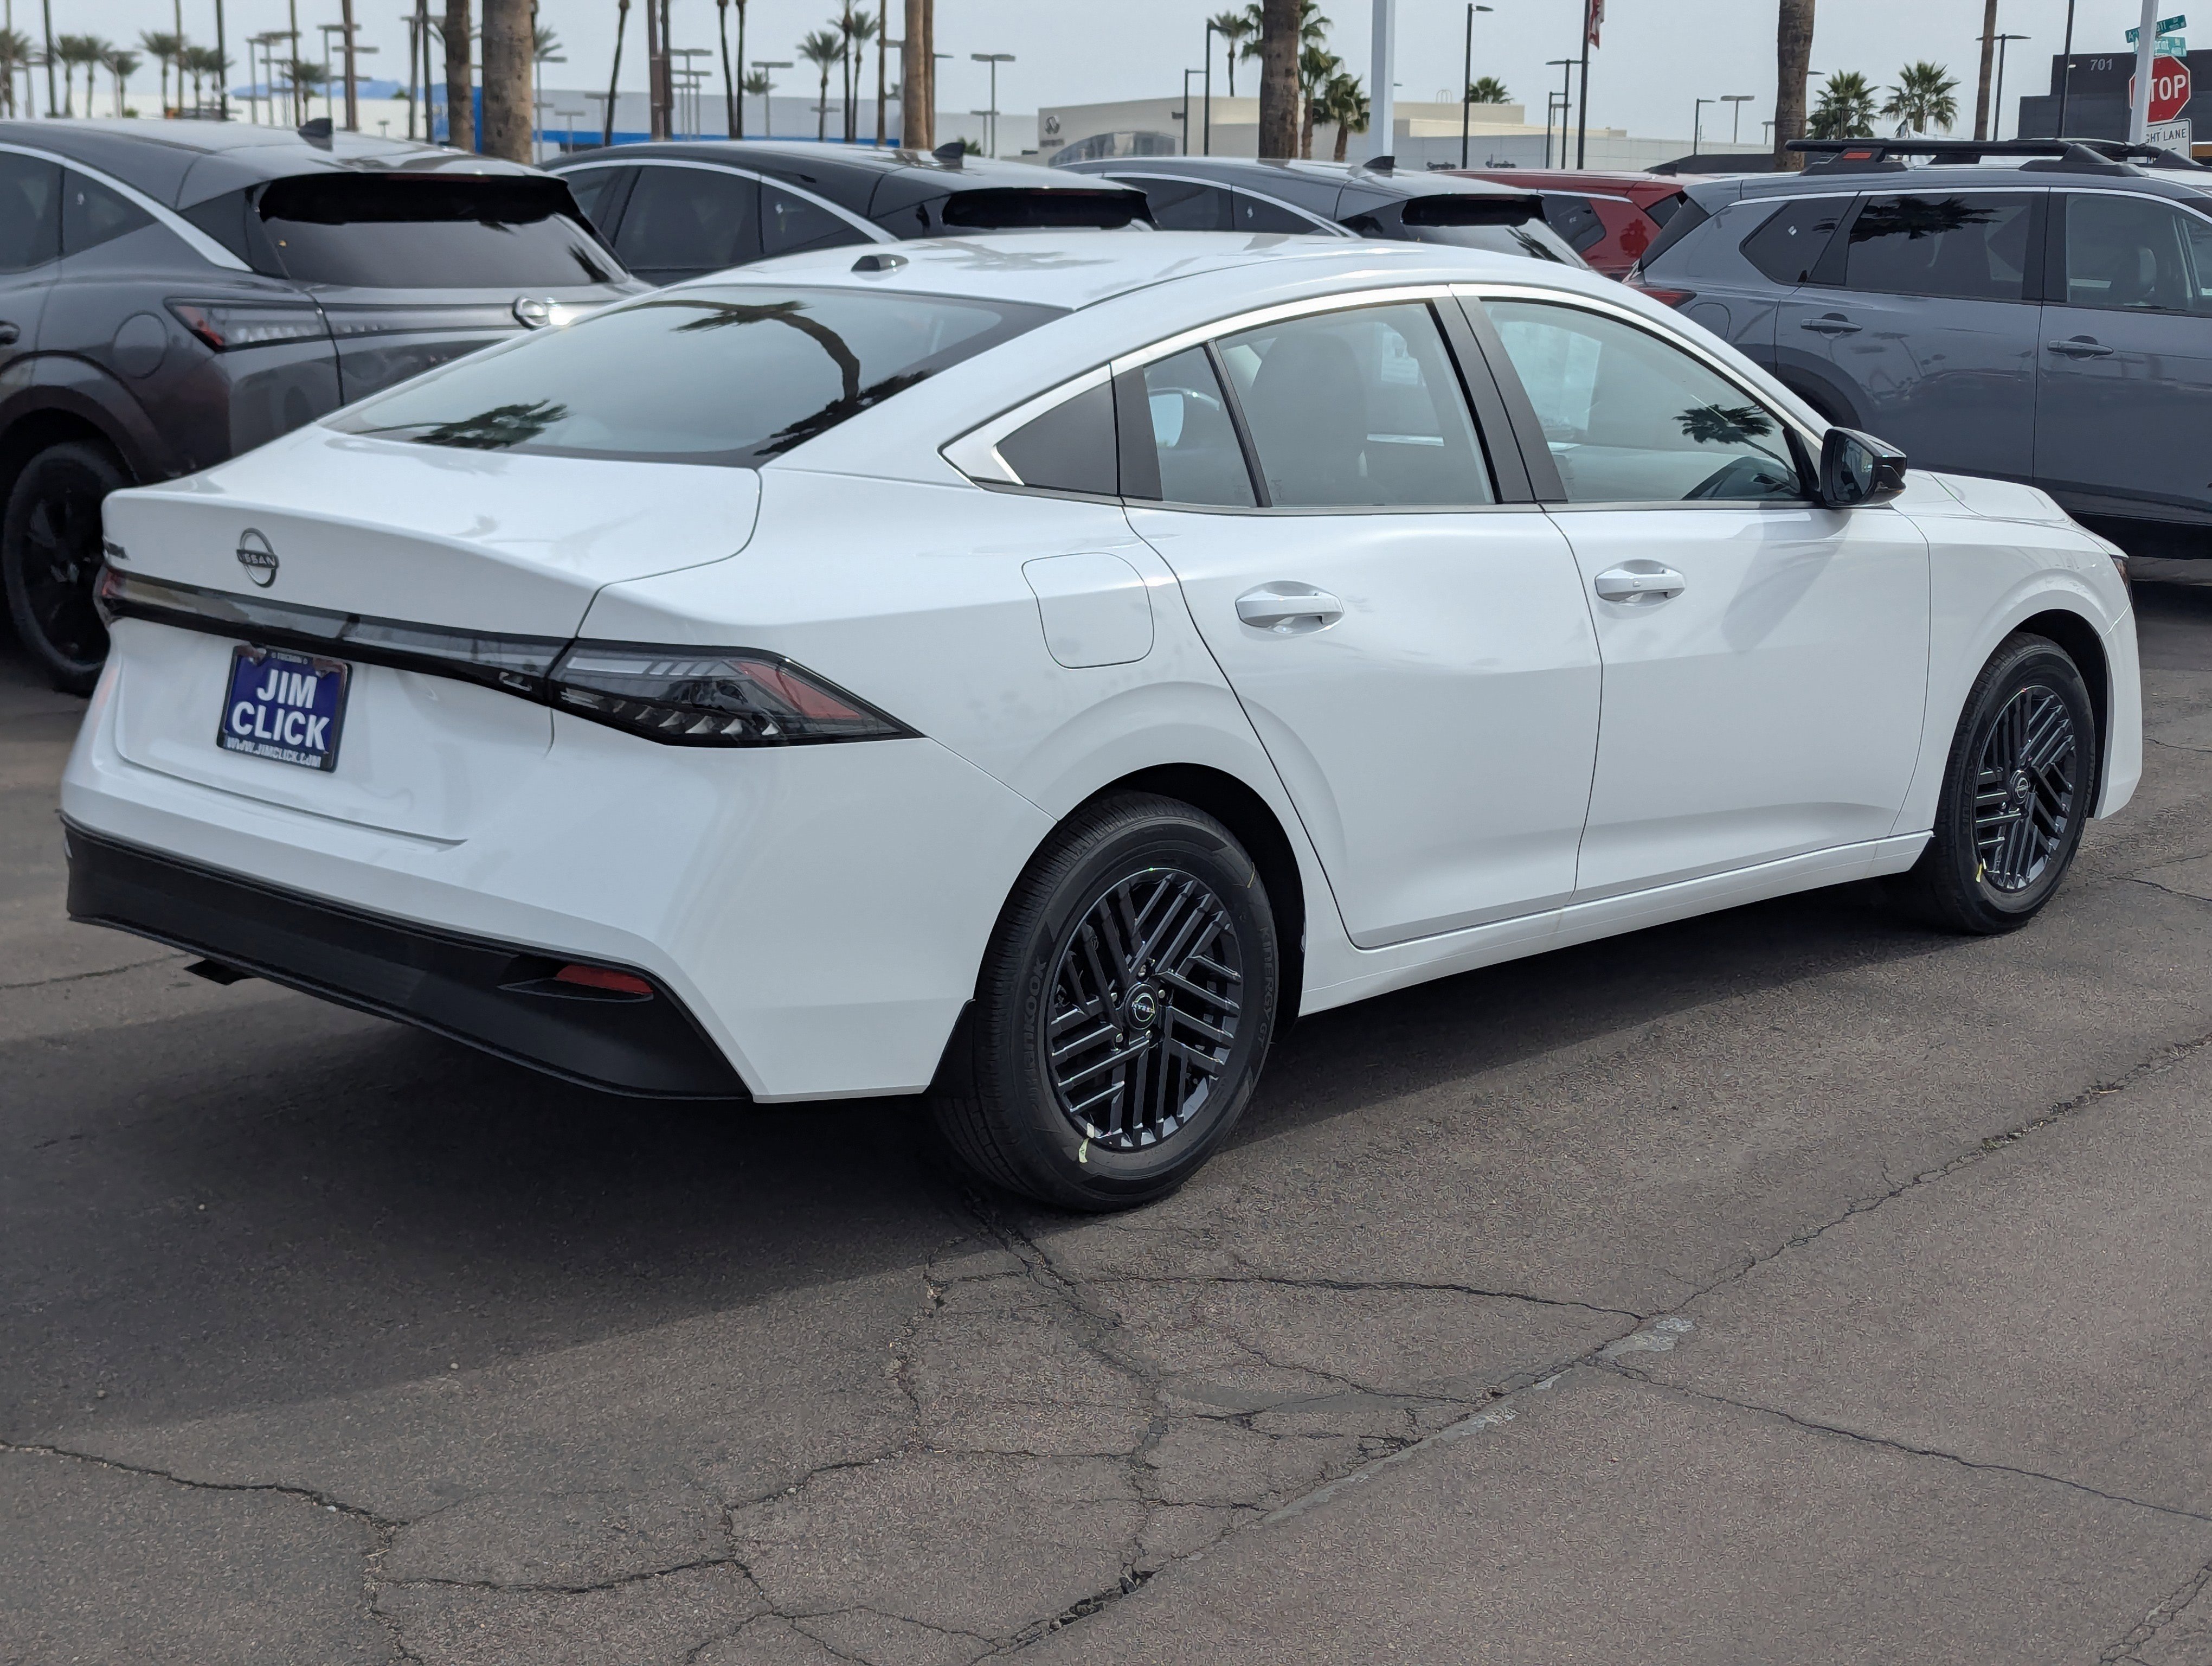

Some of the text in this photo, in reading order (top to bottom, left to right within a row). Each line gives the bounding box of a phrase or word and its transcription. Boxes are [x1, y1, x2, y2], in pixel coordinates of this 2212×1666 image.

[2090, 58, 2112, 71] 701
[2150, 74, 2187, 102] TOP
[2145, 128, 2187, 144] GHT LANE
[238, 552, 276, 567] NISSAN
[256, 668, 318, 709] JIM
[232, 701, 330, 751] CLICK
[226, 736, 322, 768] WWW.JIMCLICK.COM
